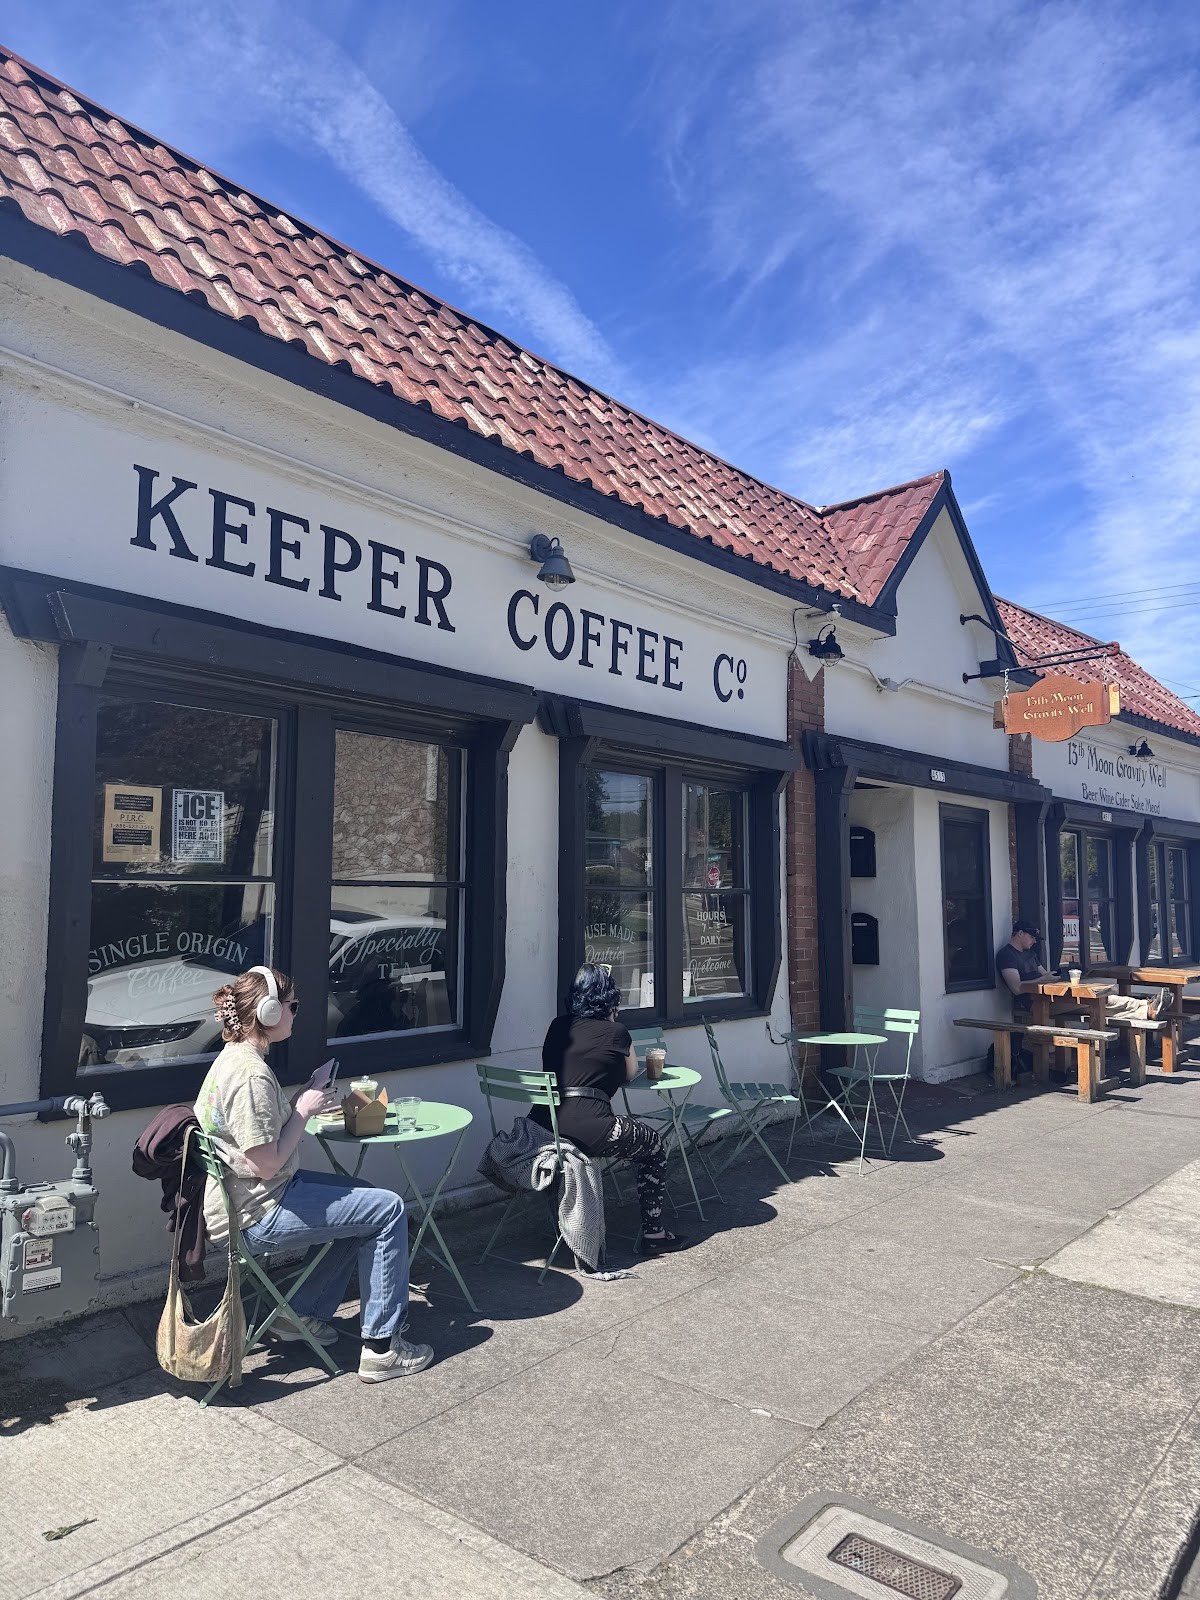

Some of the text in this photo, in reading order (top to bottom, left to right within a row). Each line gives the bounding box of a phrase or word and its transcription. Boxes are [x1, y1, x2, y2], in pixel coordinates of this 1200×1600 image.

[130, 463, 456, 633] KEEPER
[507, 588, 684, 691] COFFEE
[1050, 692, 1083, 703] Moon
[1023, 702, 1093, 719] Gravity Well
[1067, 741, 1167, 789] 13th Moon Gravity Well
[182, 794, 216, 820] ICE
[1081, 782, 1098, 801] Beer
[1099, 786, 1115, 805] Wine
[1115, 791, 1130, 808] Cider
[1130, 793, 1145, 811] Sake
[178, 831, 197, 840] HERE
[696, 911, 726, 921] HOURS
[609, 923, 637, 945] MADE
[701, 922, 707, 933] 7
[340, 925, 443, 974] Specialty
[700, 935, 722, 945] DAILY
[88, 930, 249, 973] SINGLE ORIGIN
[377, 961, 413, 981] TEA
[688, 956, 732, 976] Welcome
[127, 966, 205, 999] Coffee
[891, 1530, 941, 1554] Oldcastle
